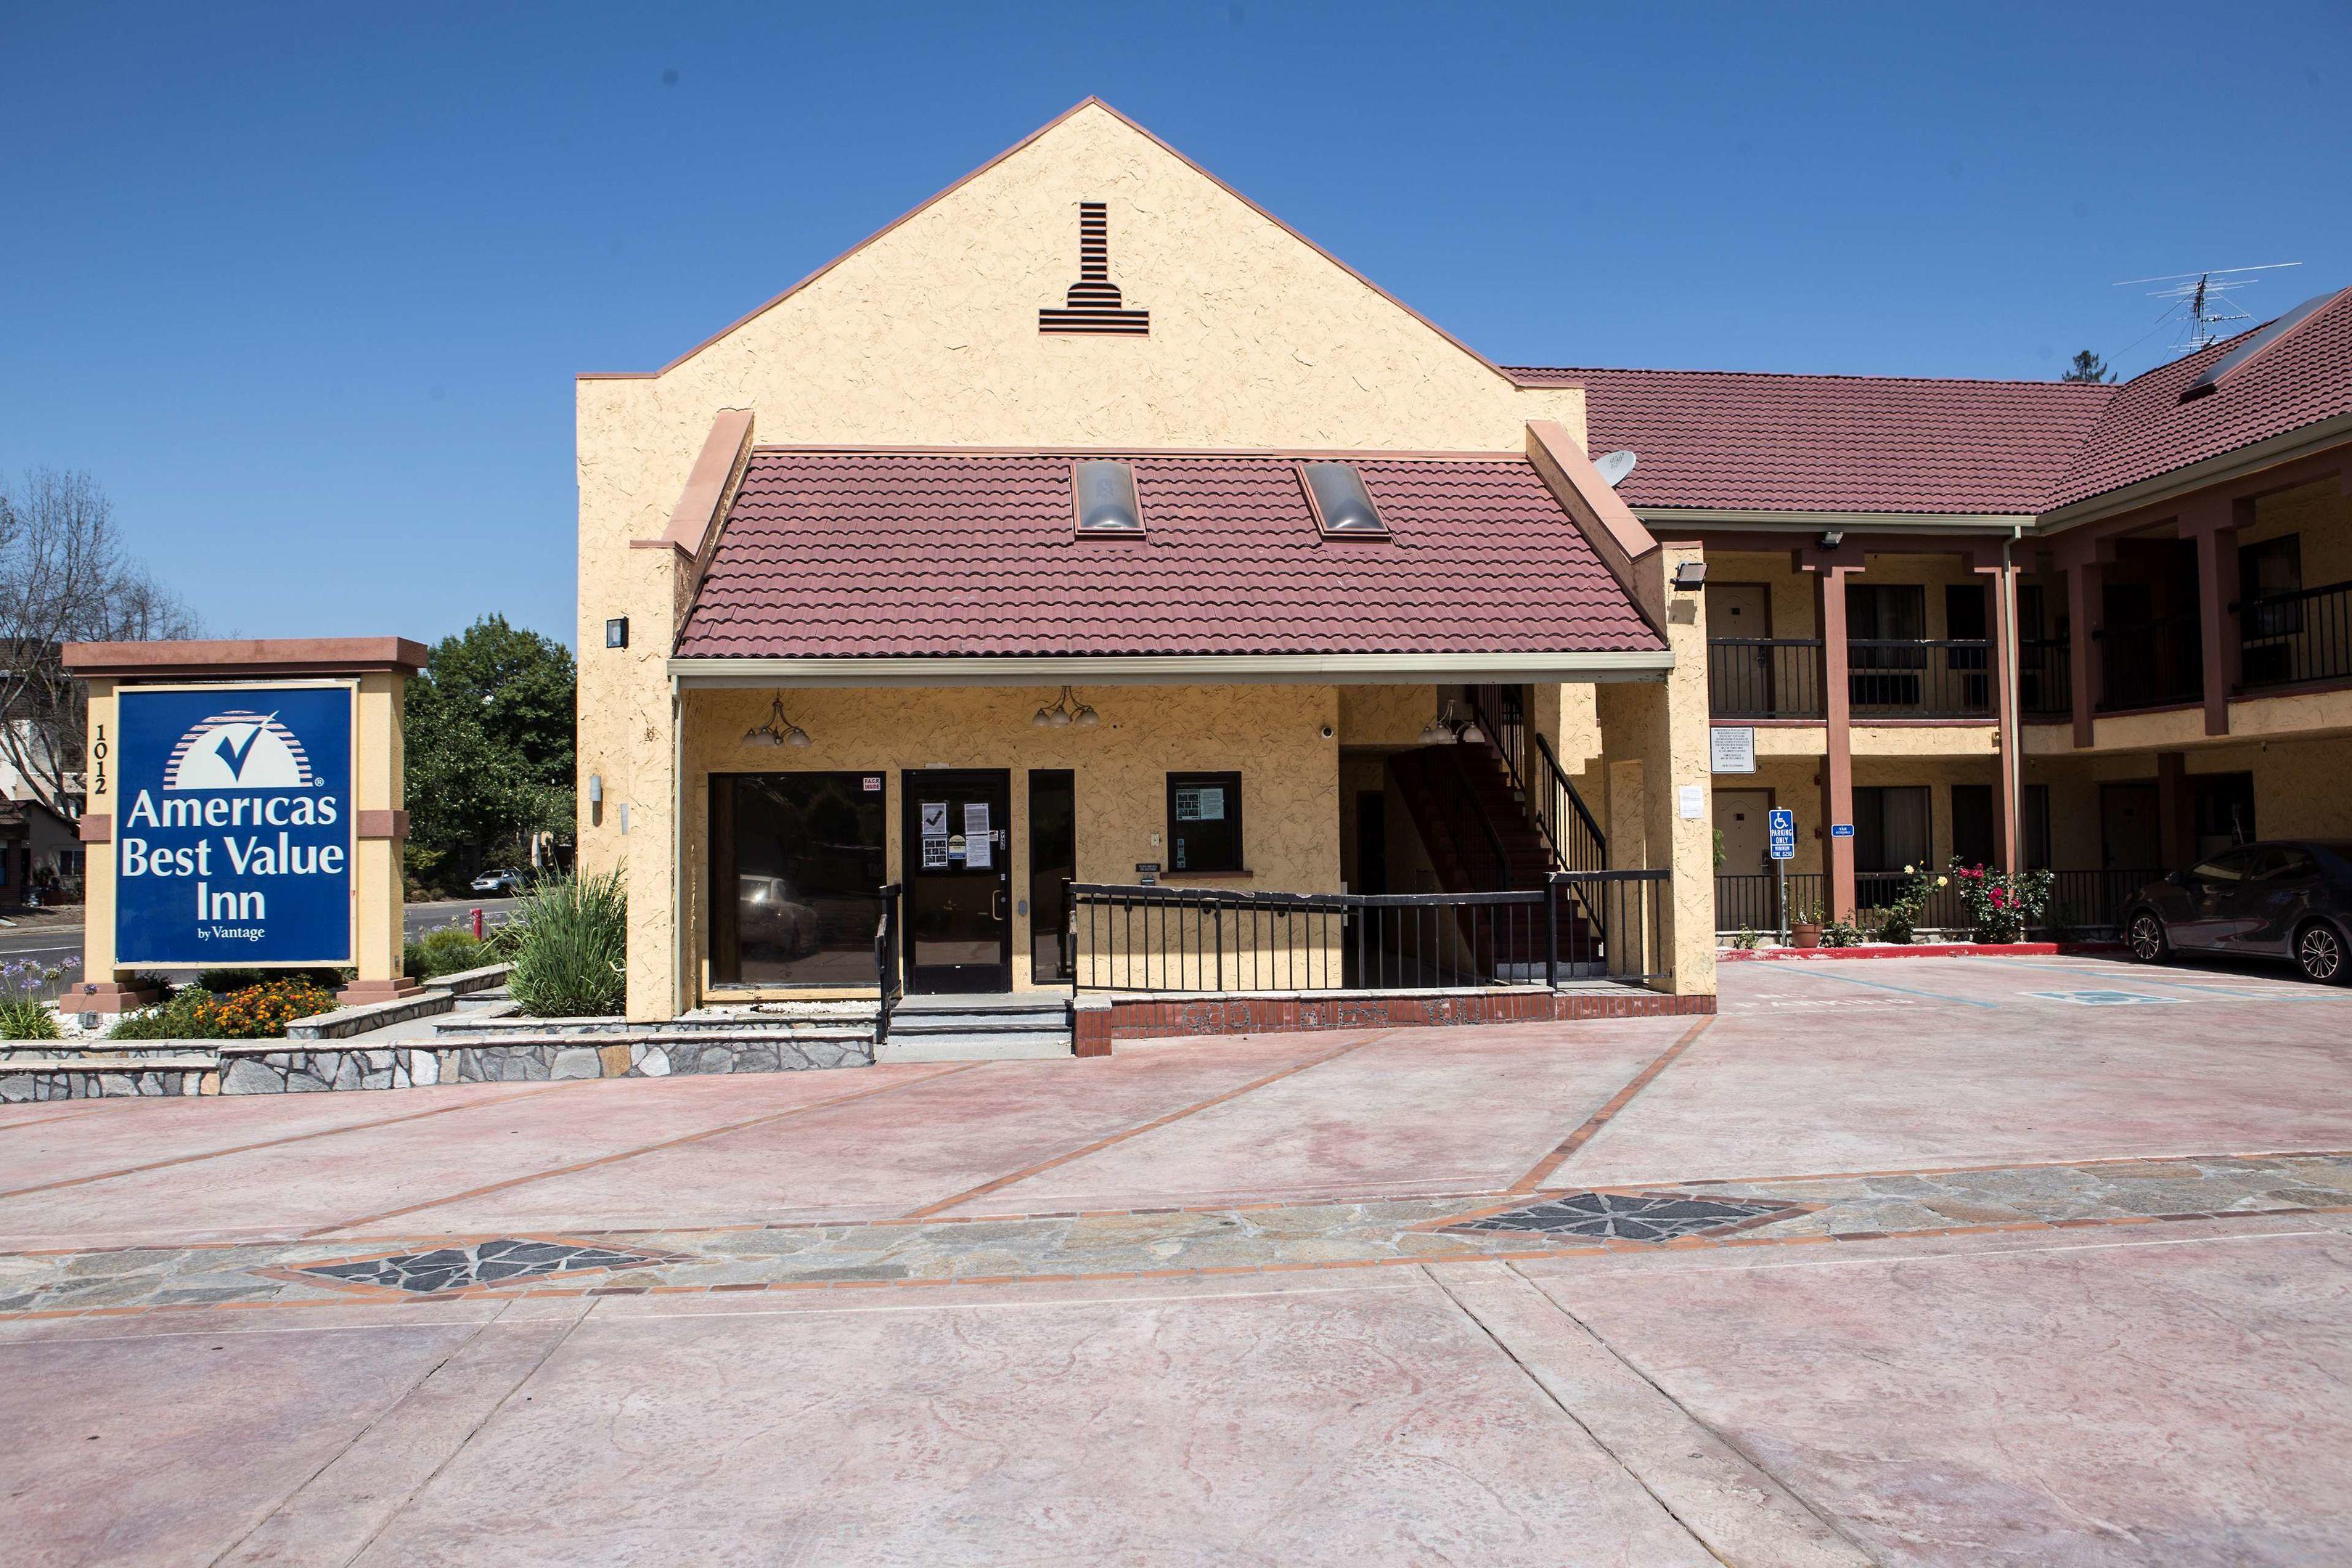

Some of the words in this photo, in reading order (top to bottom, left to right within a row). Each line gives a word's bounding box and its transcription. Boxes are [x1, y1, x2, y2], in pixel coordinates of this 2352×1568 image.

[94, 724, 108, 795] 1012
[126, 789, 337, 828] Americas
[122, 838, 212, 877] Best
[223, 831, 344, 875] Value
[197, 882, 266, 920] Inn
[197, 928, 211, 941] by
[211, 926, 266, 942] Vantage
